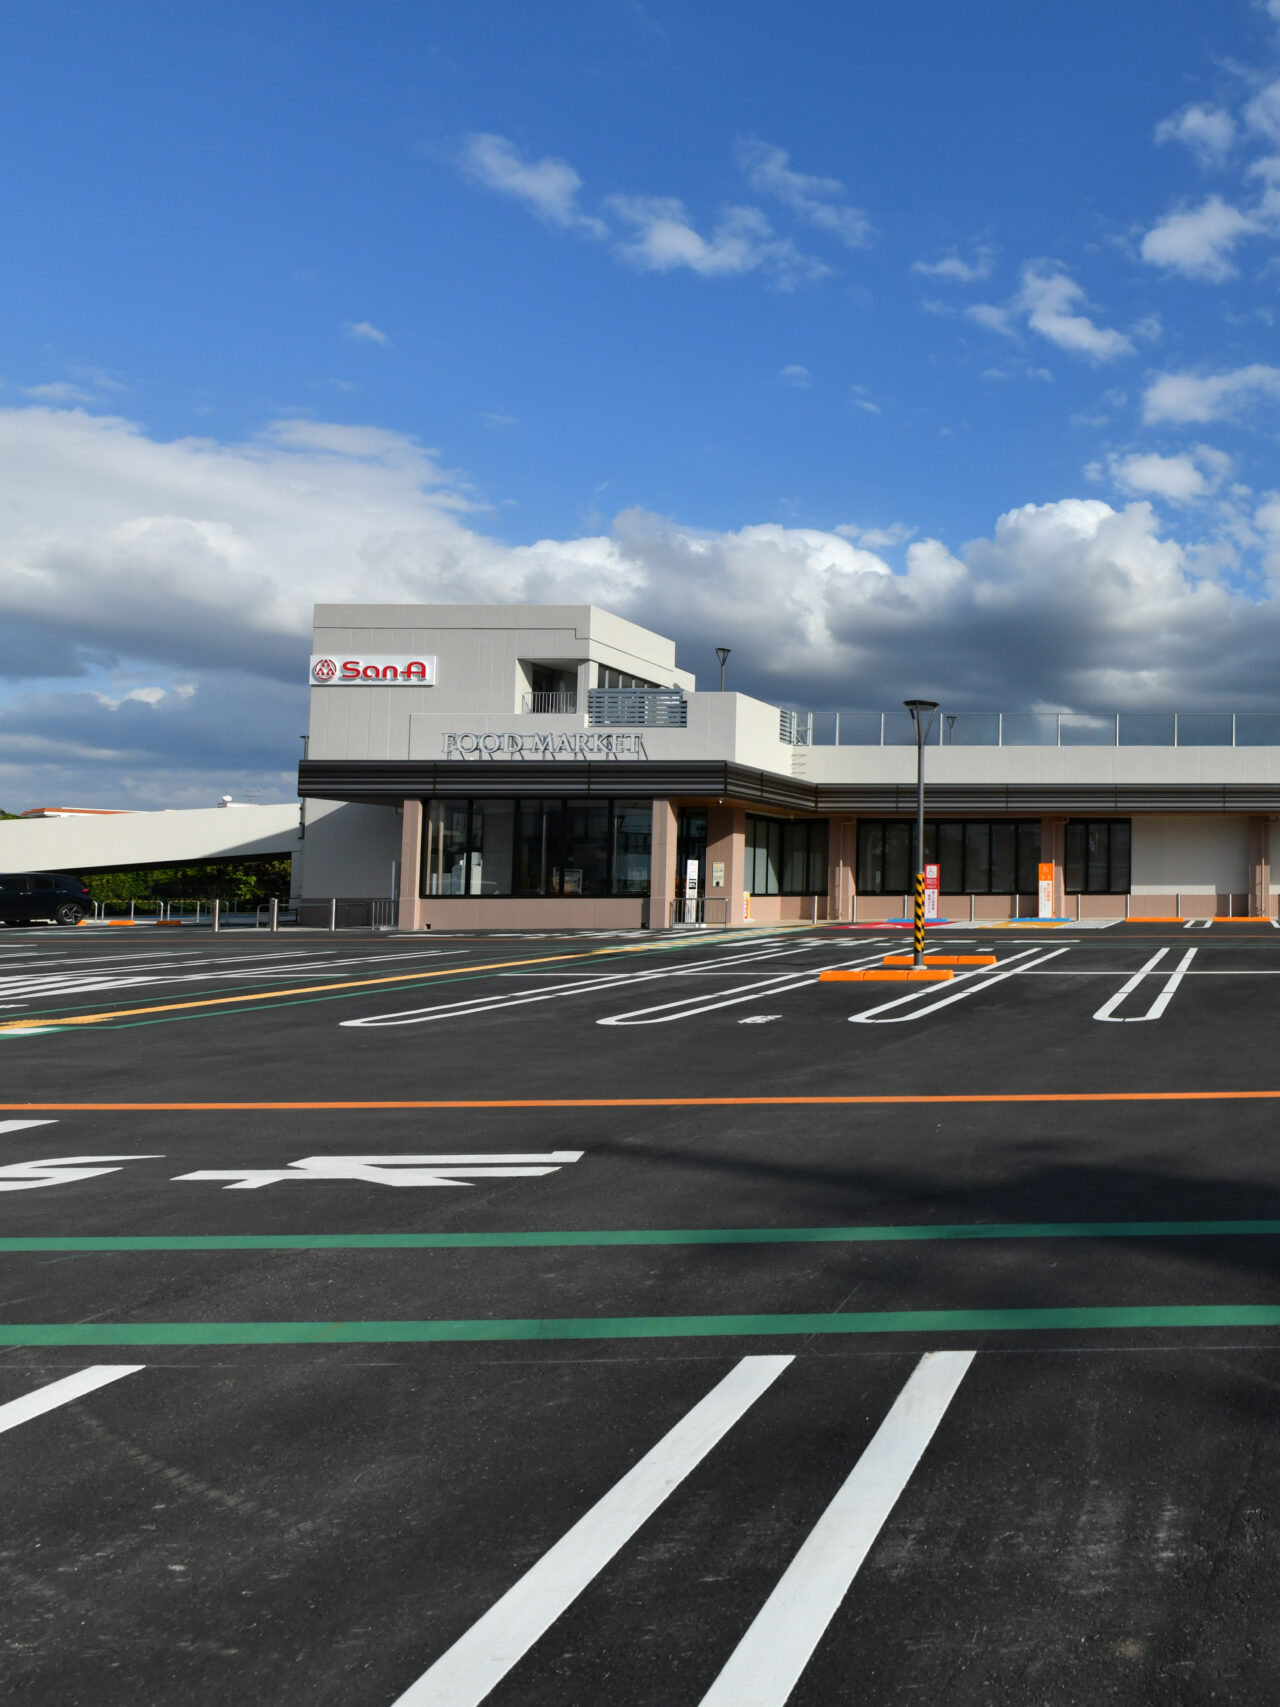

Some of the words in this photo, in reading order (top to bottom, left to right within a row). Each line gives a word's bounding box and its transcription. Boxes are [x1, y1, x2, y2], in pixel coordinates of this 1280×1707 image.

[341, 660, 427, 679] San-A
[442, 733, 524, 754] FOOD
[531, 732, 643, 754] MARKET
